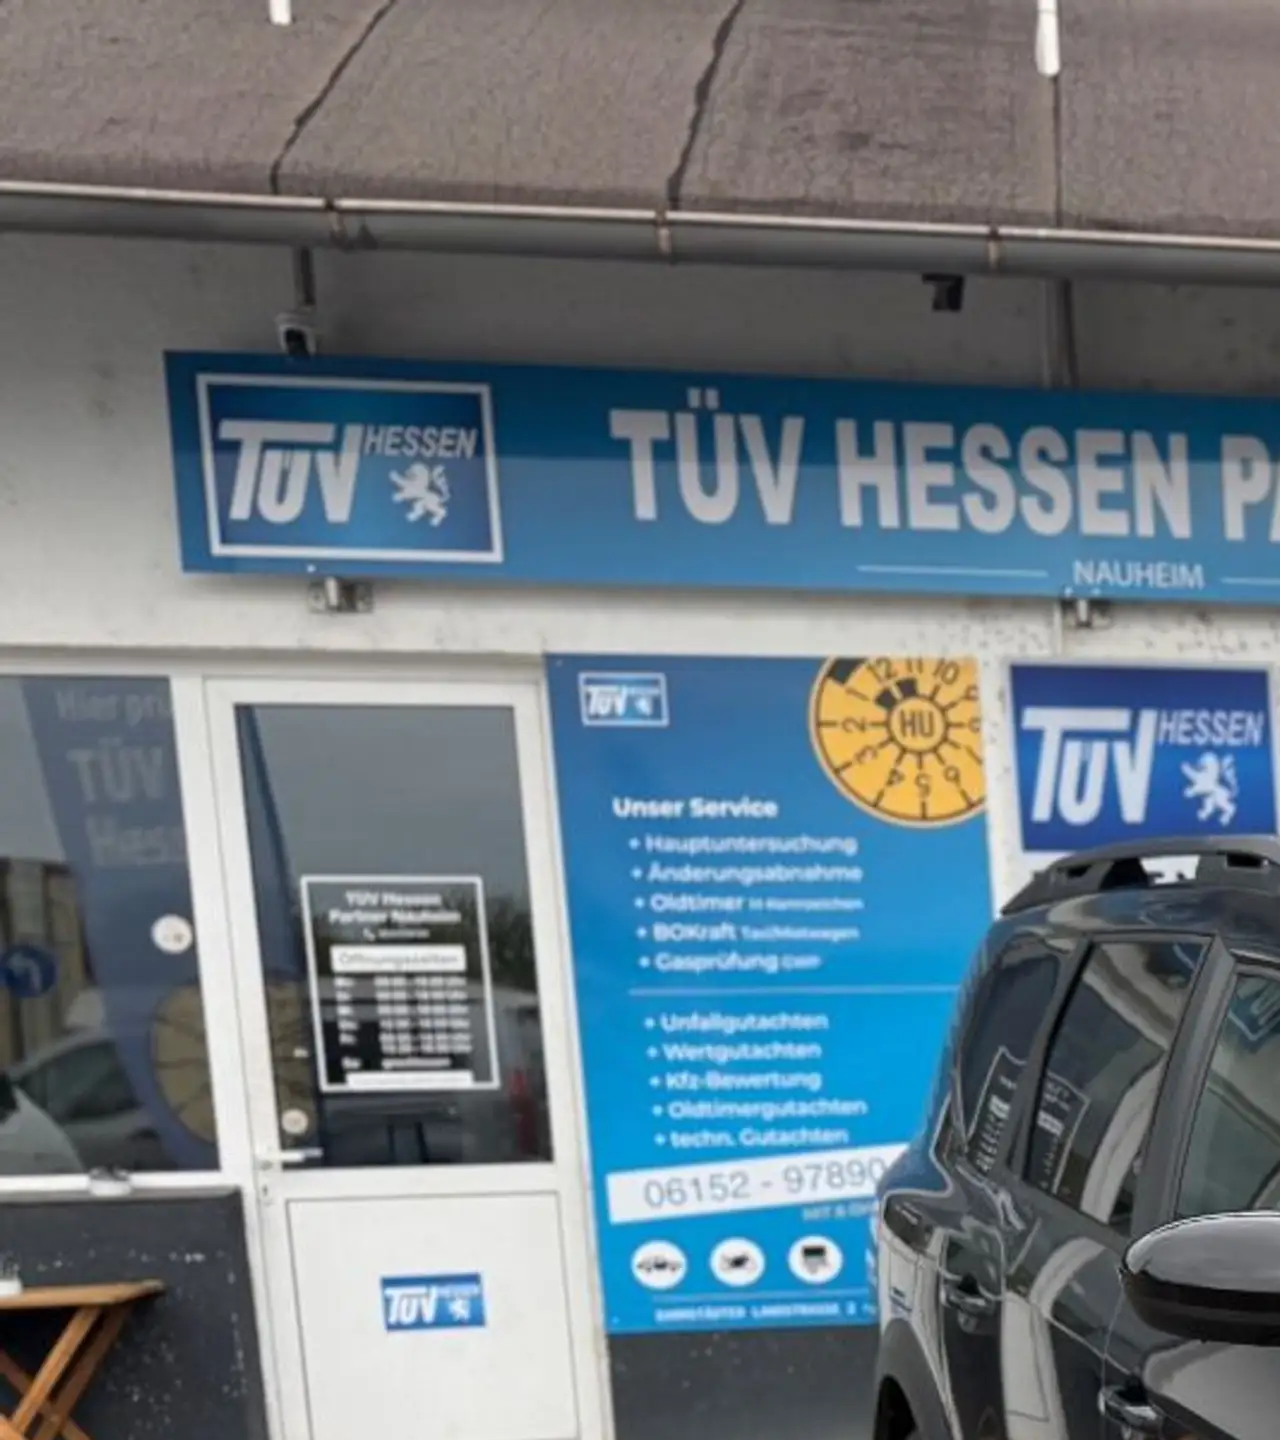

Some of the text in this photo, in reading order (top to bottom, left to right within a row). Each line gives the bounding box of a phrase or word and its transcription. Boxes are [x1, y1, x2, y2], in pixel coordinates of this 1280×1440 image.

[364, 425, 477, 460] HESSEN
[609, 387, 804, 525] TÜV
[835, 419, 1191, 540] HESSEN
[1073, 560, 1204, 590] NAUHEIM
[934, 657, 961, 685] 10
[899, 709, 935, 738] HU
[1159, 708, 1265, 747] HESSEN
[66, 736, 164, 803] TÜV
[611, 796, 778, 819] Unser Service
[645, 834, 858, 857] Hauptuntersuchung
[647, 860, 863, 886] Änderungsabnahme
[650, 891, 743, 913] Oldtimer
[654, 949, 778, 975] Gasprüfung
[660, 1011, 829, 1034] Unfallgutachten
[661, 1040, 822, 1064] Wertgutachten
[665, 1069, 822, 1092] Kfz-Bewertung
[668, 1097, 869, 1122] Oldtimergutachten
[670, 1126, 849, 1149] techn. Gutachten
[643, 1170, 751, 1210] 06152
